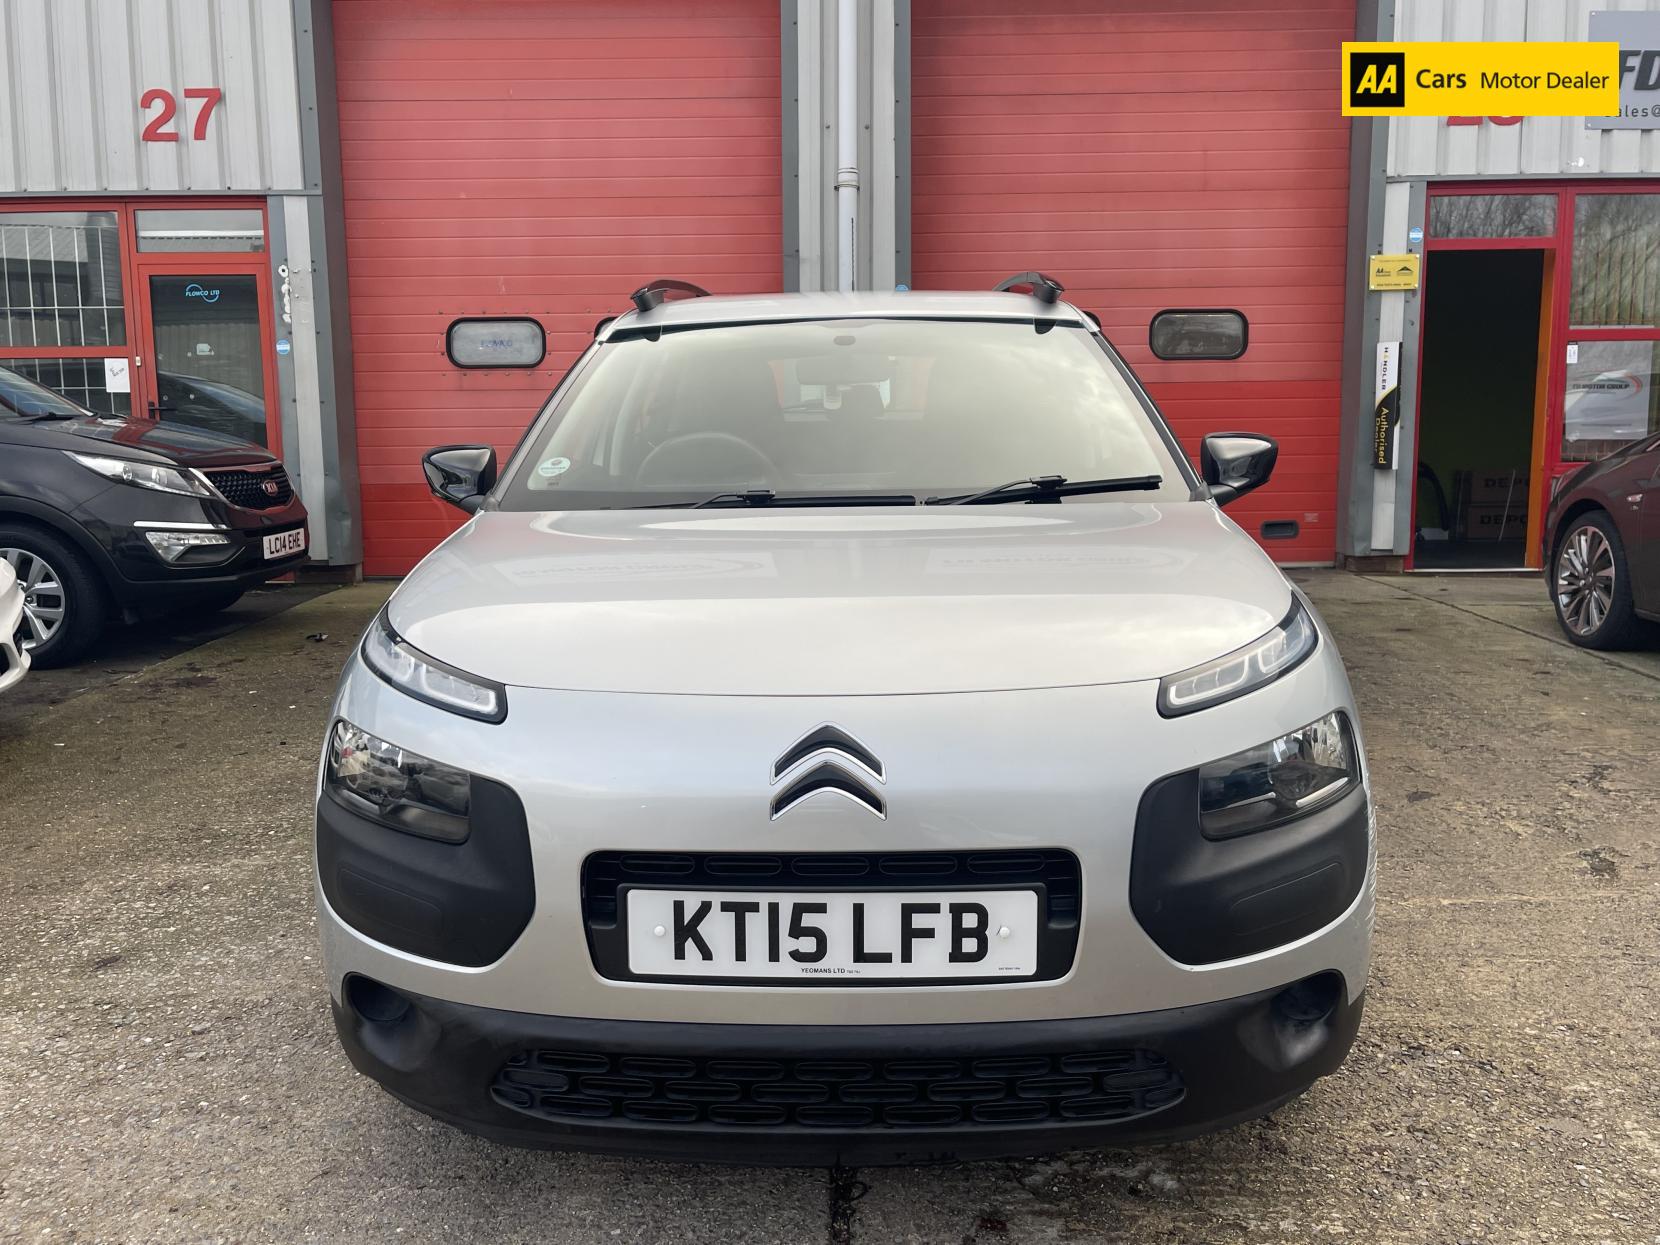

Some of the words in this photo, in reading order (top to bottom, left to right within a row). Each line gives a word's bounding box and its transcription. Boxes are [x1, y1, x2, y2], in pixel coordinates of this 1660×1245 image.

[140, 87, 223, 142] 27
[1606, 104, 1660, 118] les@
[1378, 407, 1390, 464] Authorised
[268, 534, 287, 555] LC14
[288, 531, 301, 550] EHE
[673, 899, 828, 963] KT15
[852, 902, 989, 964] LFB
